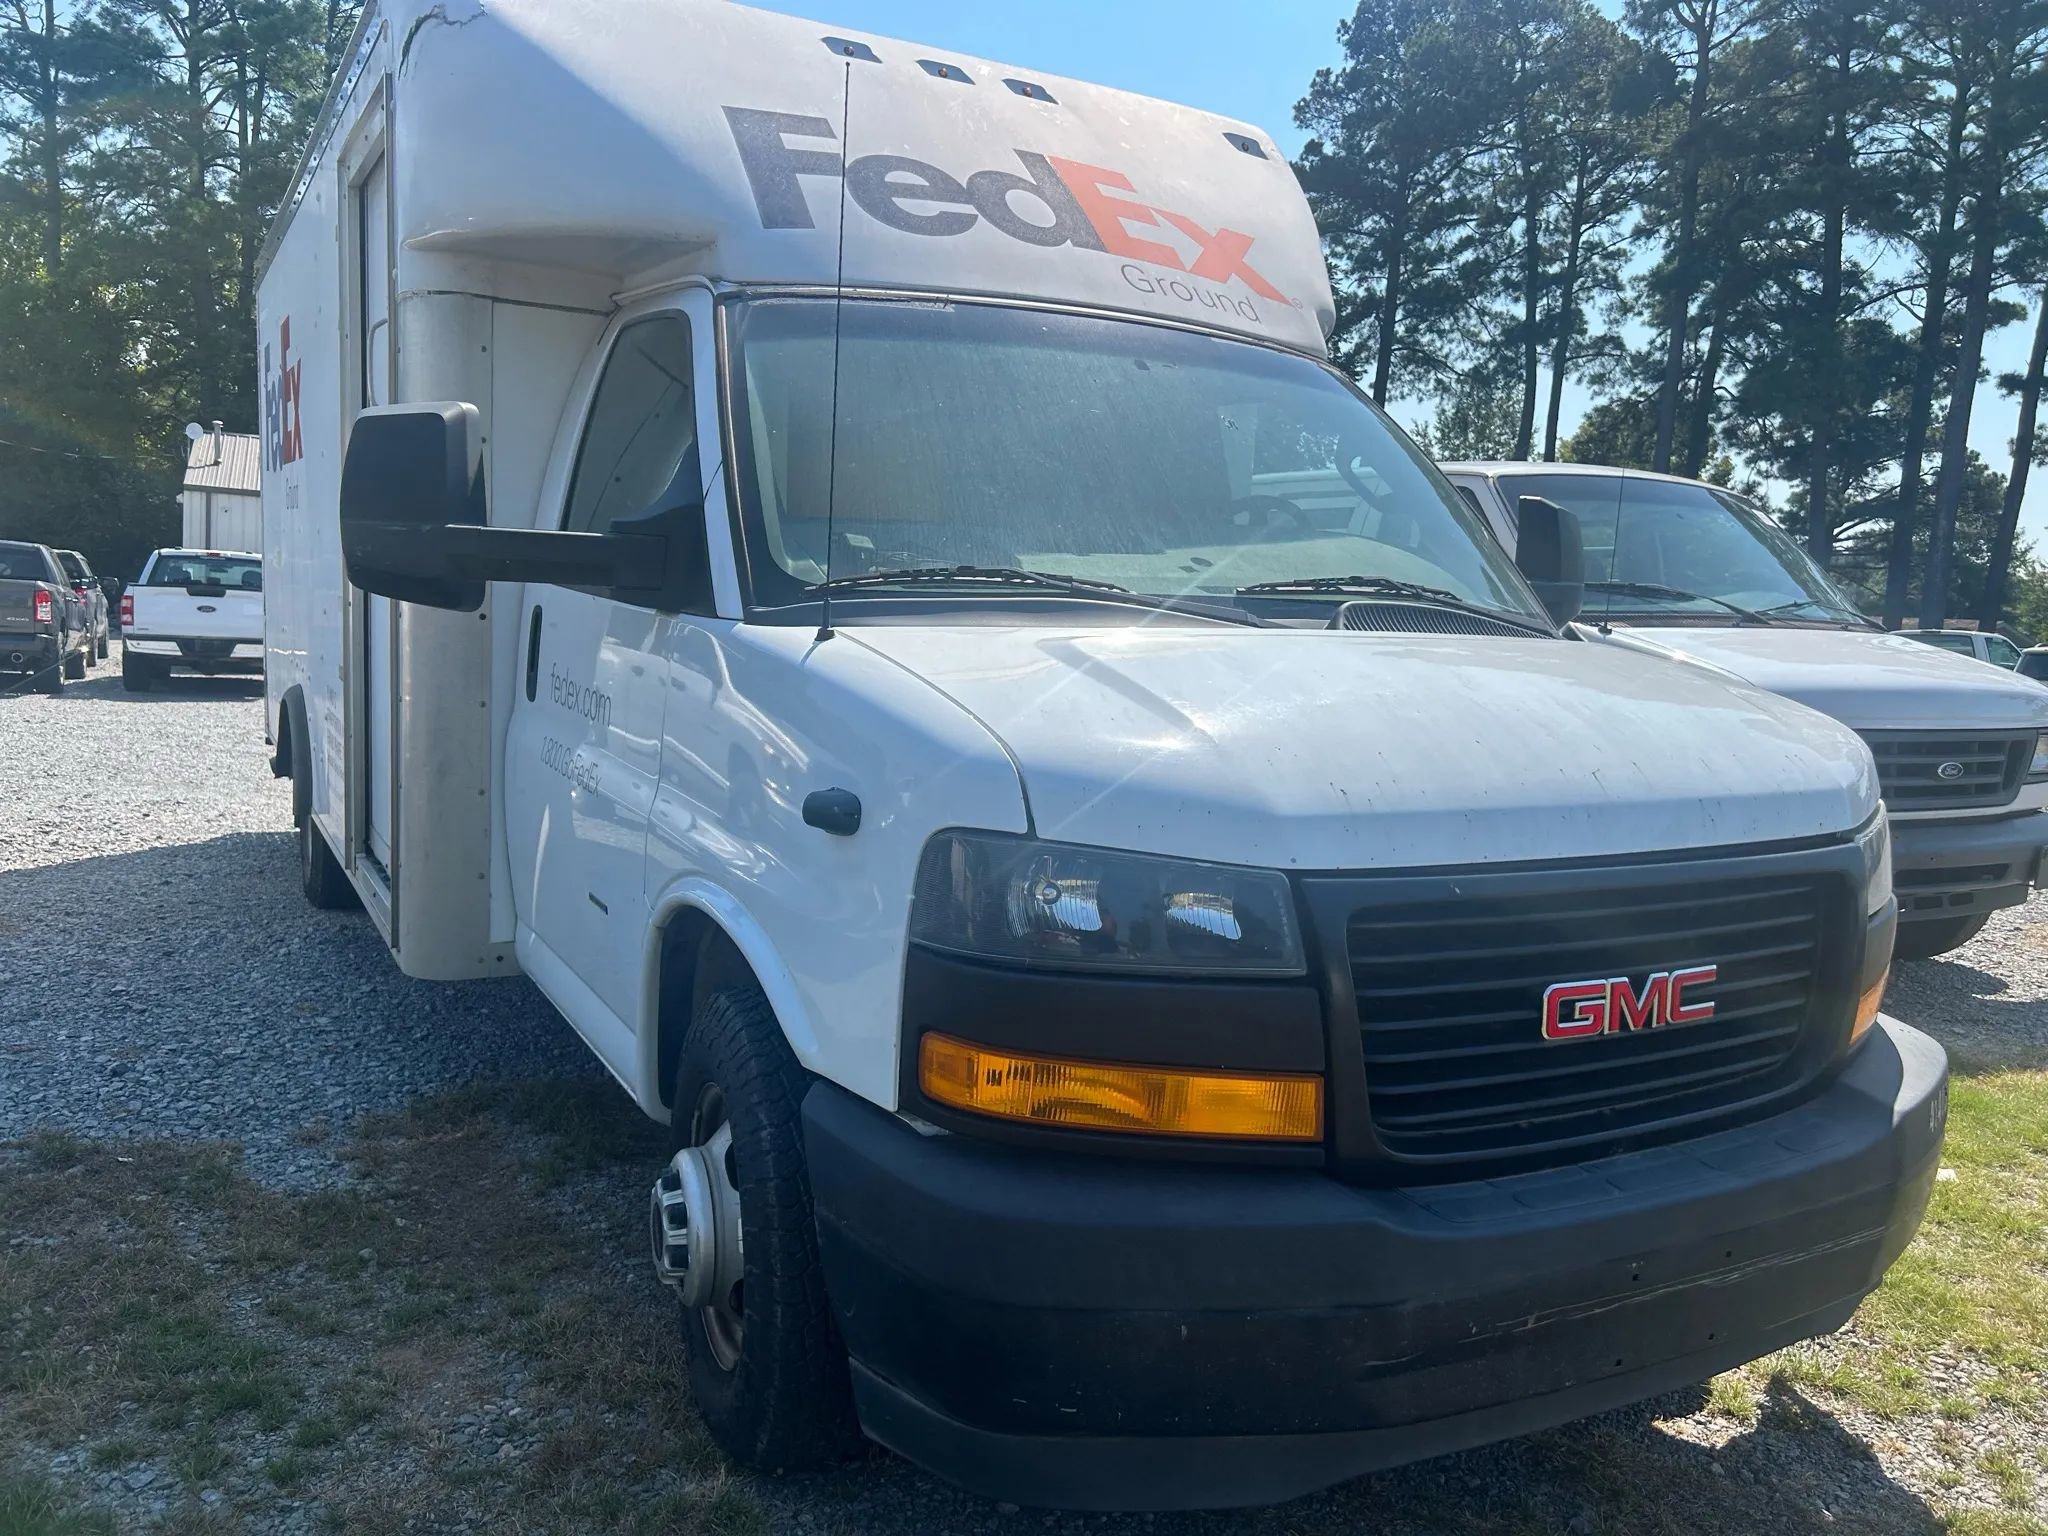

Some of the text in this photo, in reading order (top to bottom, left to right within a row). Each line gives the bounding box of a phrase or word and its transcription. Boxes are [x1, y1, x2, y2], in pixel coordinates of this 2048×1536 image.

[721, 105, 1295, 308] FedEx
[1121, 264, 1262, 324] Ground
[264, 314, 304, 473] FedEx
[550, 662, 612, 728] fedex.com
[1541, 965, 1717, 1040] GMC
